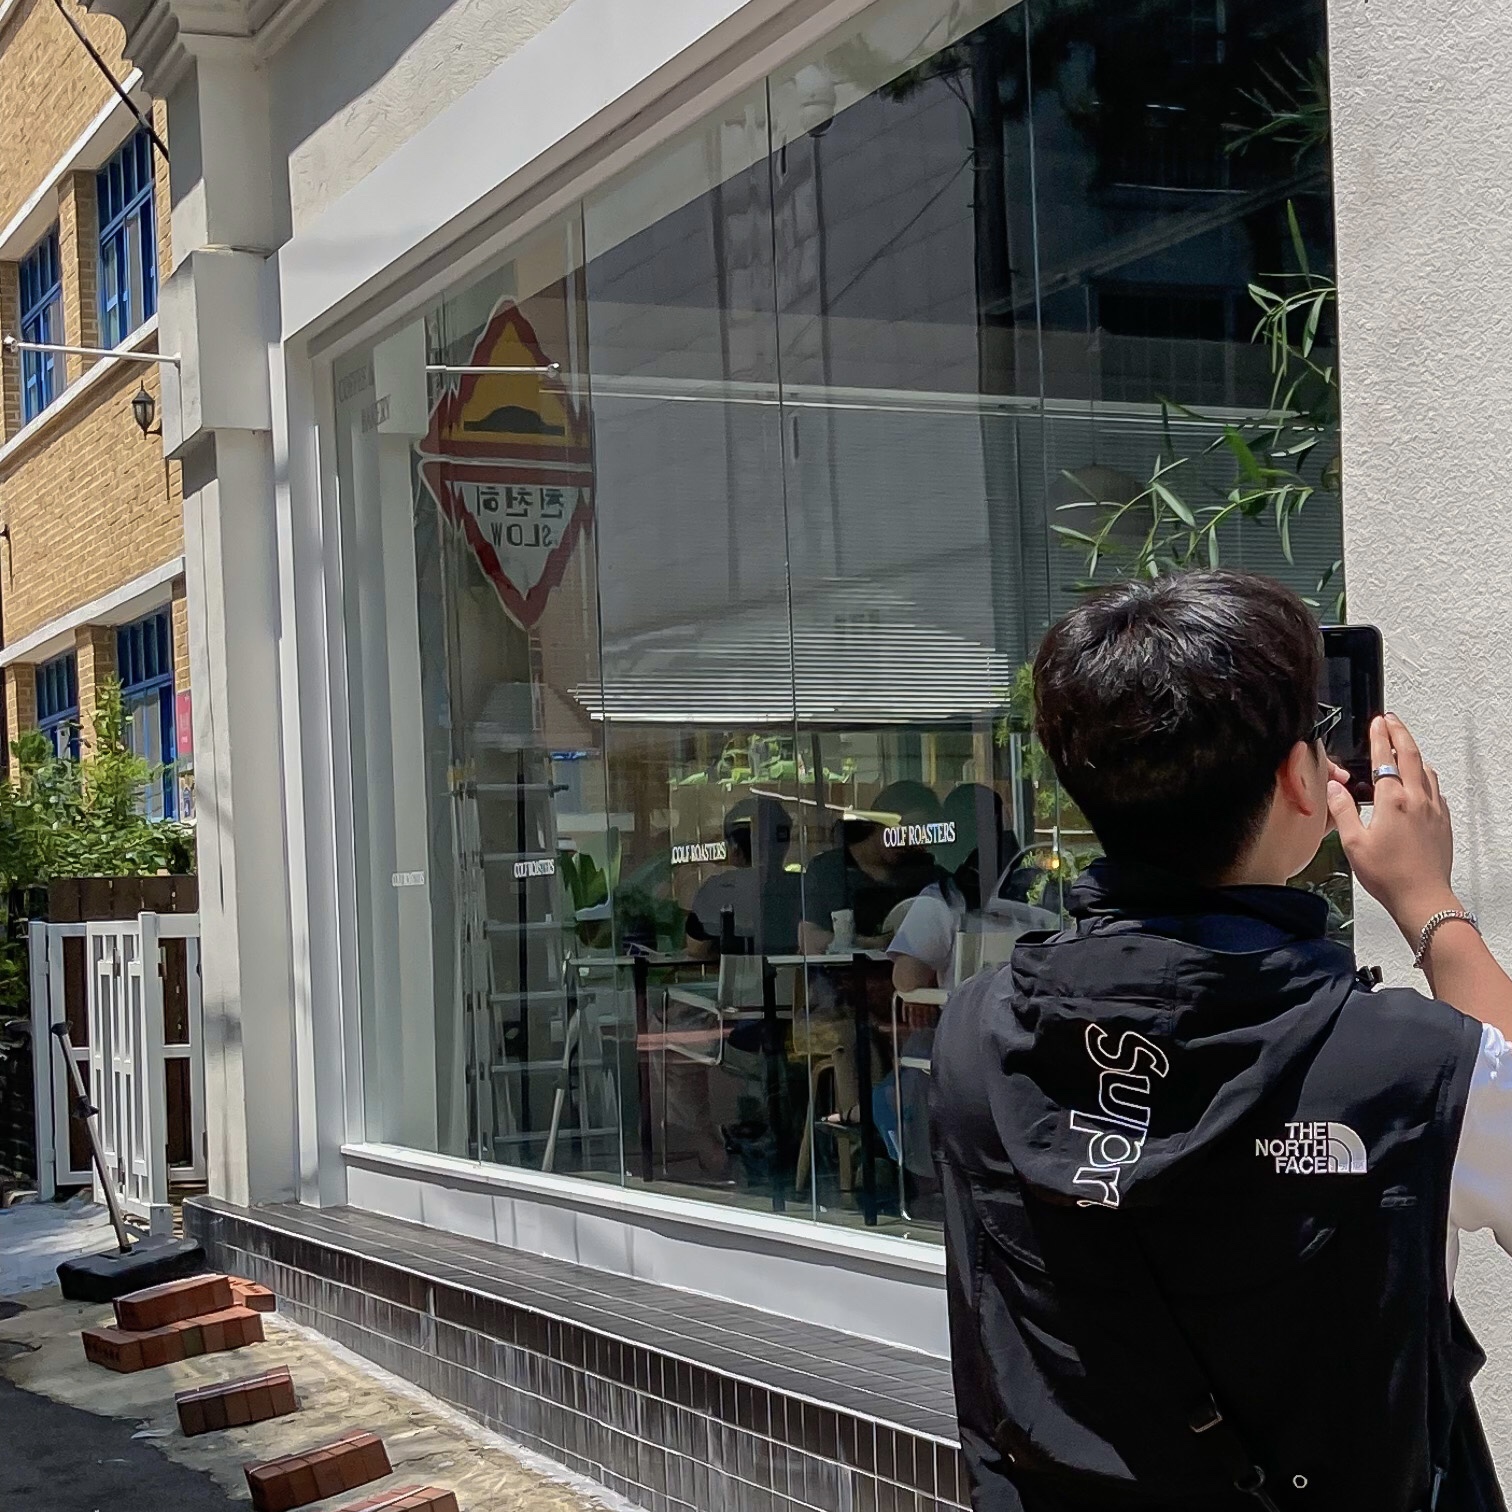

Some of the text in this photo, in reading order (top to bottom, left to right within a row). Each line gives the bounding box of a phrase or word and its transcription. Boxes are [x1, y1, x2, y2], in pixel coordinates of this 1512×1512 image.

[908, 821, 956, 846] ROASTERS
[1069, 1022, 1170, 1209] Supr
[1284, 1121, 1327, 1140] THE
[1254, 1138, 1327, 1158] NORTH
[1274, 1156, 1328, 1175] FACE
